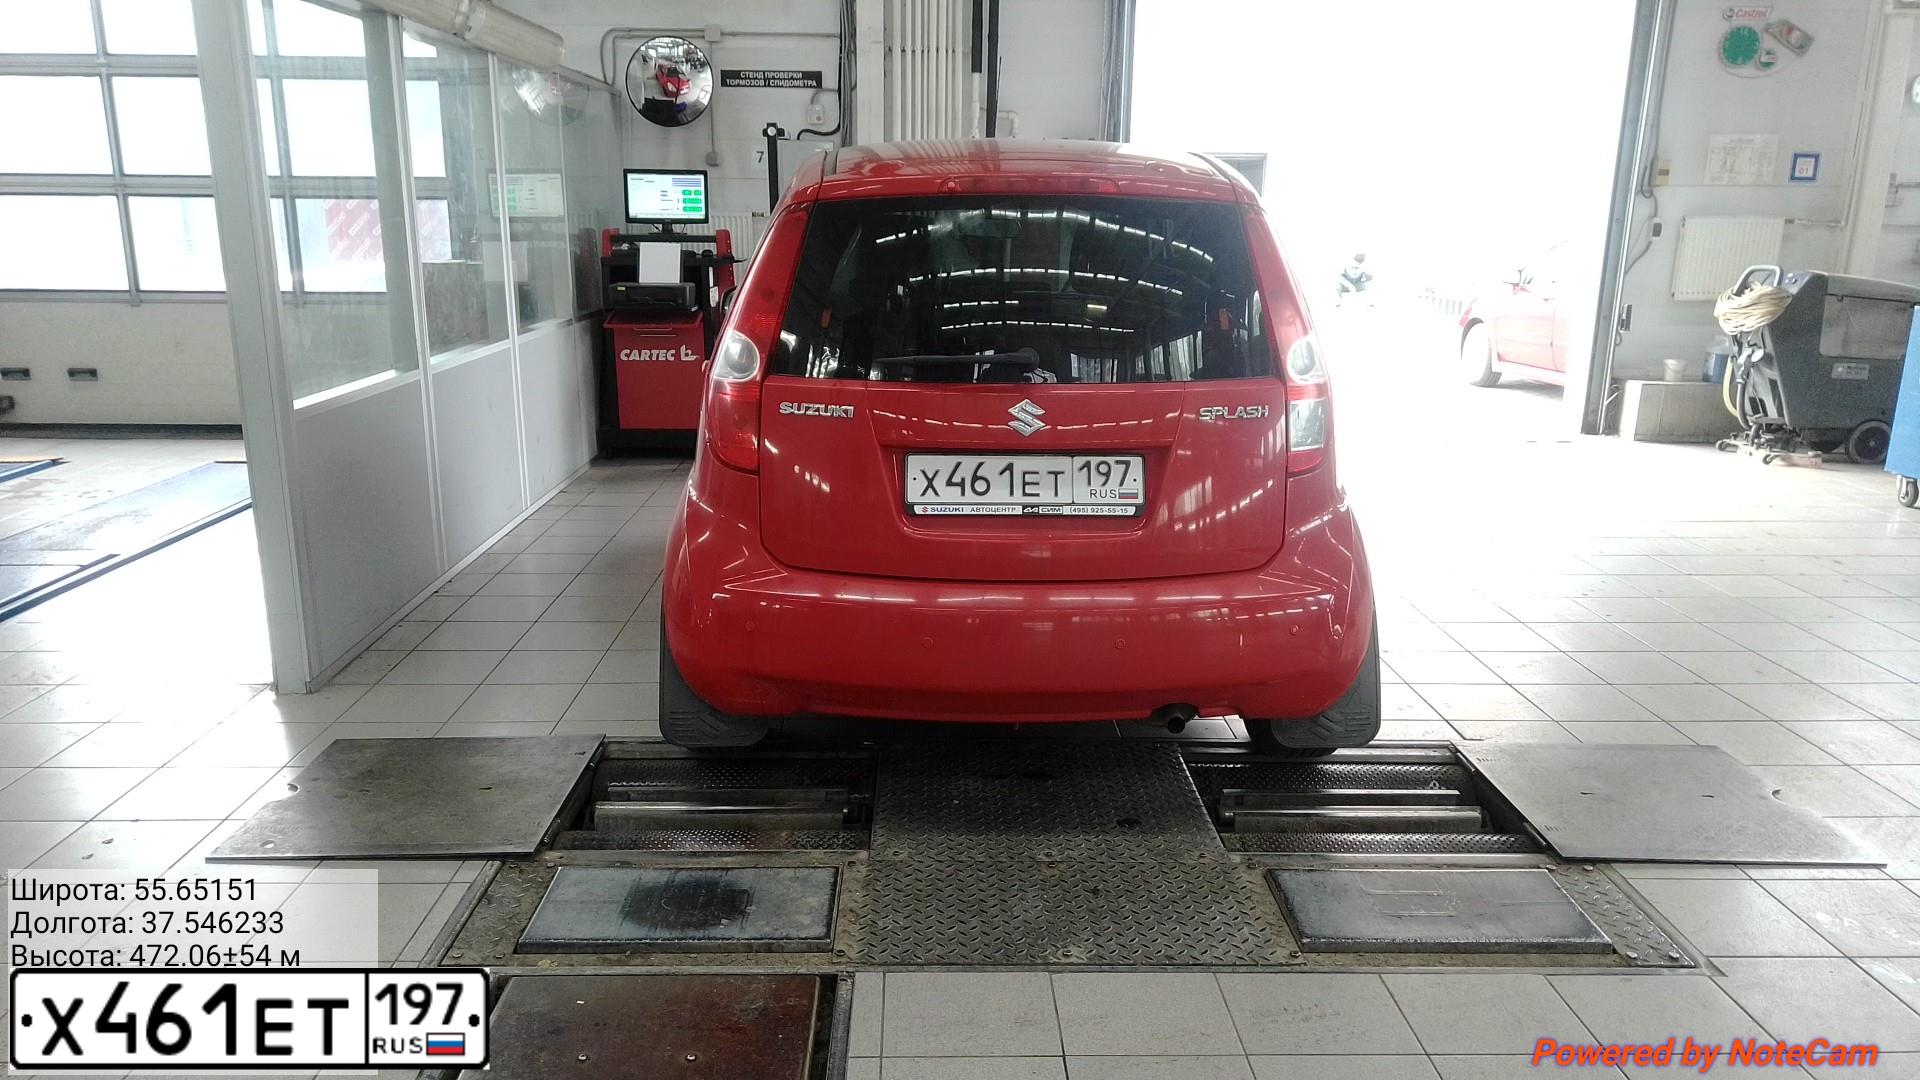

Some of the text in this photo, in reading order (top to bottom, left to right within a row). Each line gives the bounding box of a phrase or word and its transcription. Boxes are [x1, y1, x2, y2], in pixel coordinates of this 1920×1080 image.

[740, 71, 803, 79] СТЕНД ПРОВЕРКИ
[770, 79, 817, 87] СПИДОМЕТРА
[756, 150, 764, 163] 7
[620, 349, 675, 361] CARTEC
[779, 401, 855, 418] SUZUKI
[1199, 405, 1269, 420] SPLASH
[1077, 460, 1131, 487] 197
[1089, 488, 1117, 499] RUS
[1069, 506, 1089, 514] (495)
